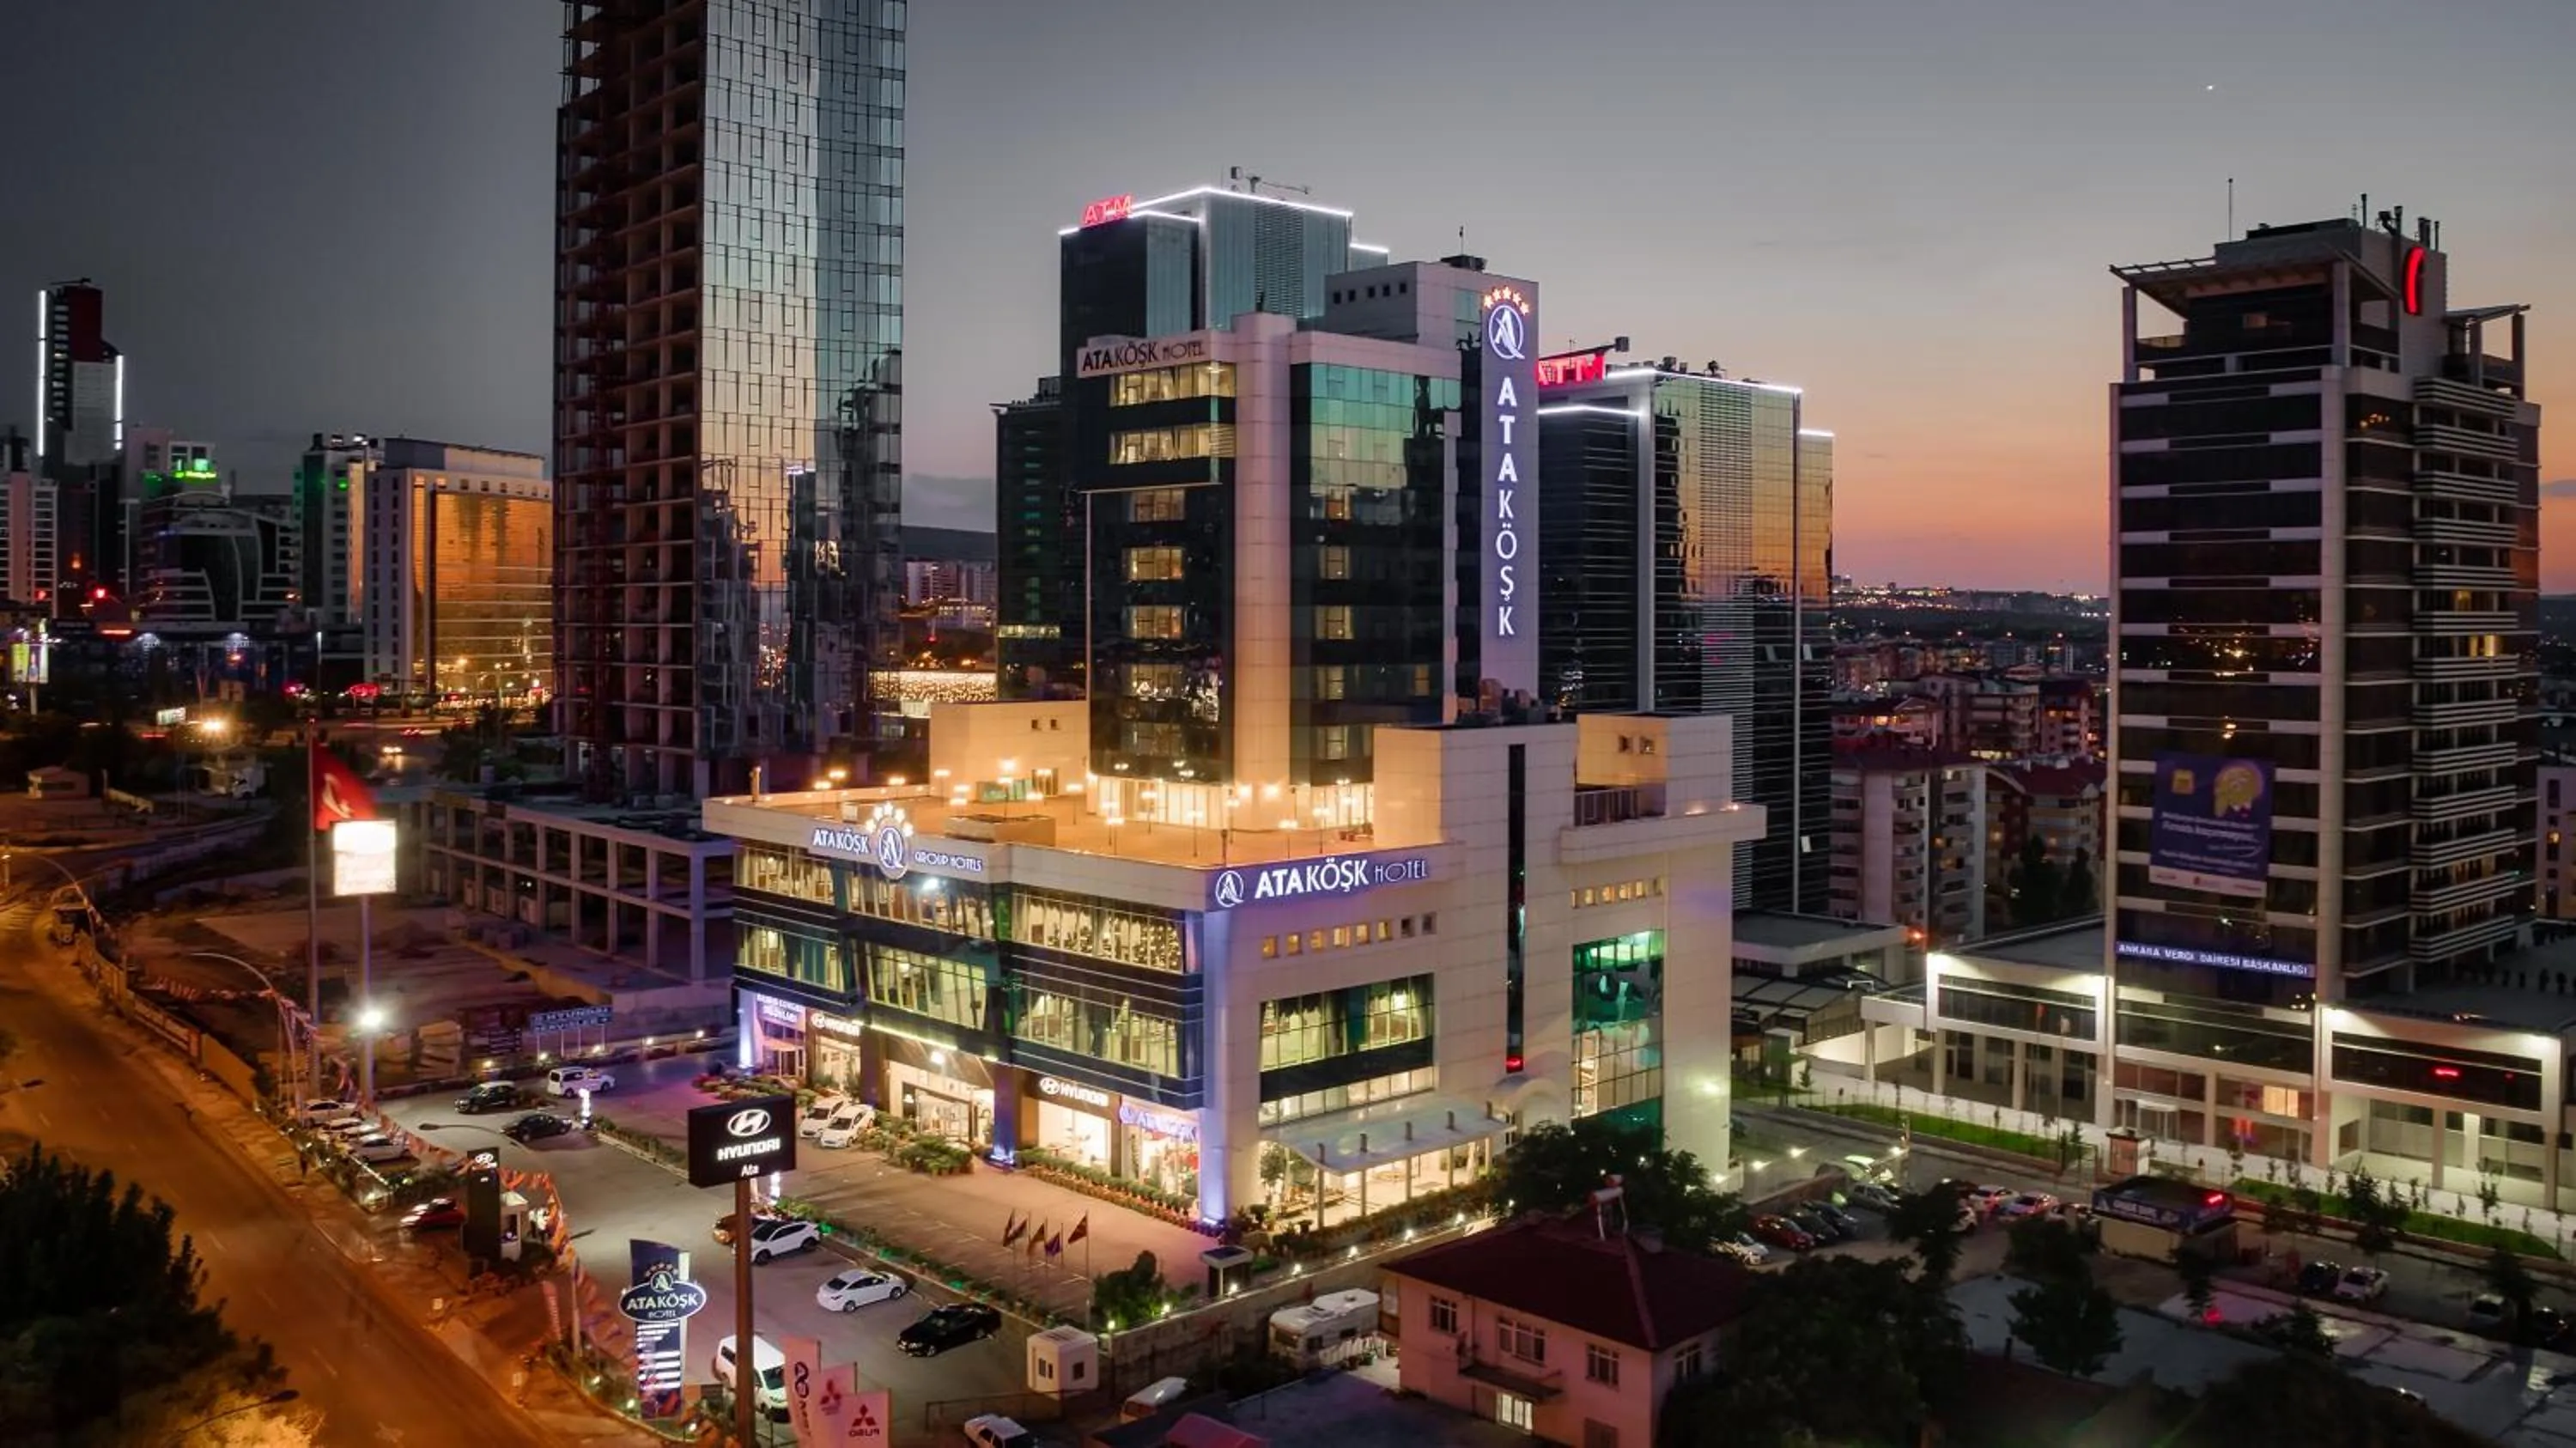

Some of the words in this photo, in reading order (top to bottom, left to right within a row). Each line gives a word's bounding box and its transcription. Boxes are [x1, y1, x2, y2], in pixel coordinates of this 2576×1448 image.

[1084, 195, 1132, 224] ATM
[1496, 376, 1518, 636] ATAKÖŞK
[1254, 857, 1370, 900] ATAKÖŞK
[1374, 860, 1428, 883] HOTEL
[2118, 944, 2161, 957] ANKARA
[1060, 1081, 1109, 1107] HYUNDAI
[716, 1137, 781, 1161] HYUNDAI
[626, 1293, 698, 1311] ATAKÖŞK
